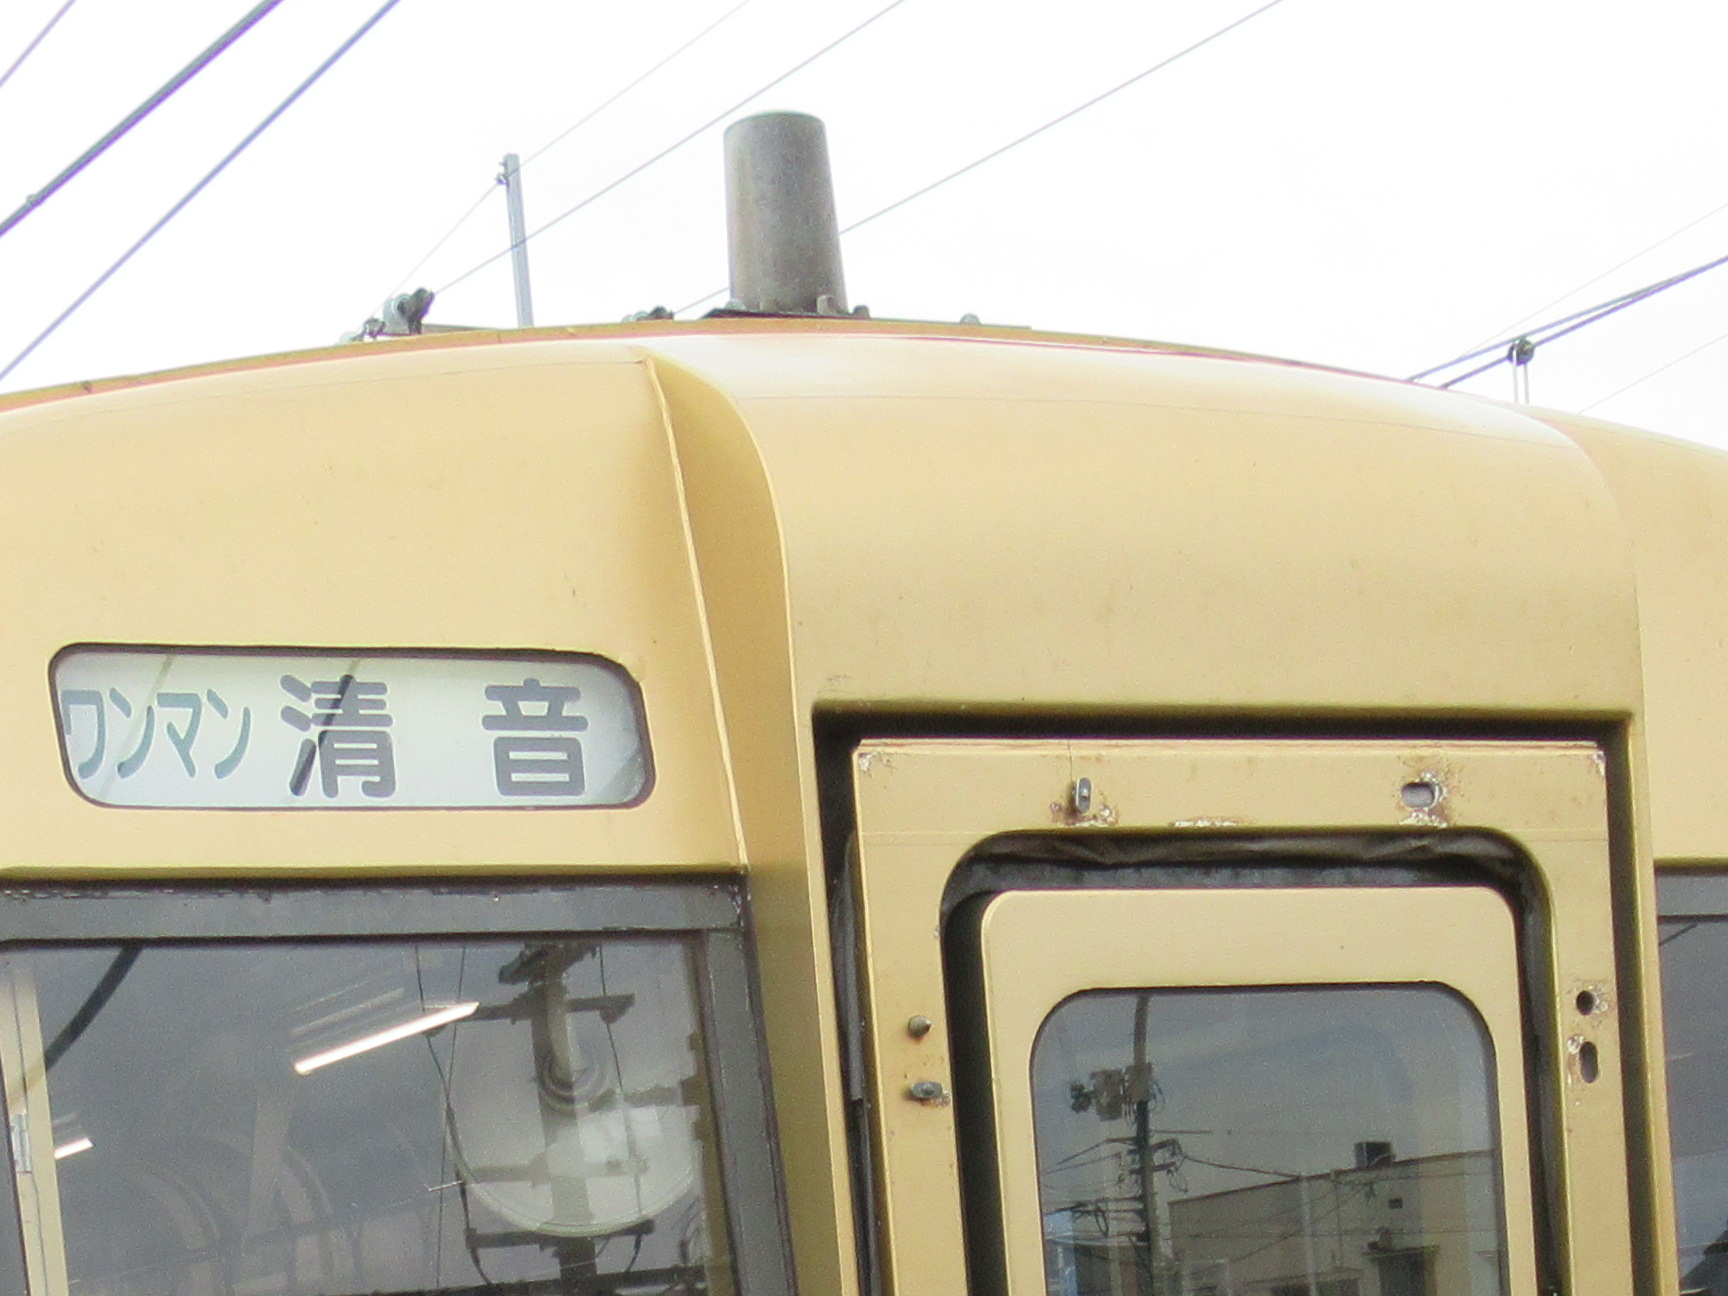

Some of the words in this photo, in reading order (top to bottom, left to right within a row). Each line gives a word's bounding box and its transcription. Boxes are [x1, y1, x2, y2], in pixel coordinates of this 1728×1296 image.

[60, 687, 252, 780] ワンマン
[280, 673, 590, 799] 清音
